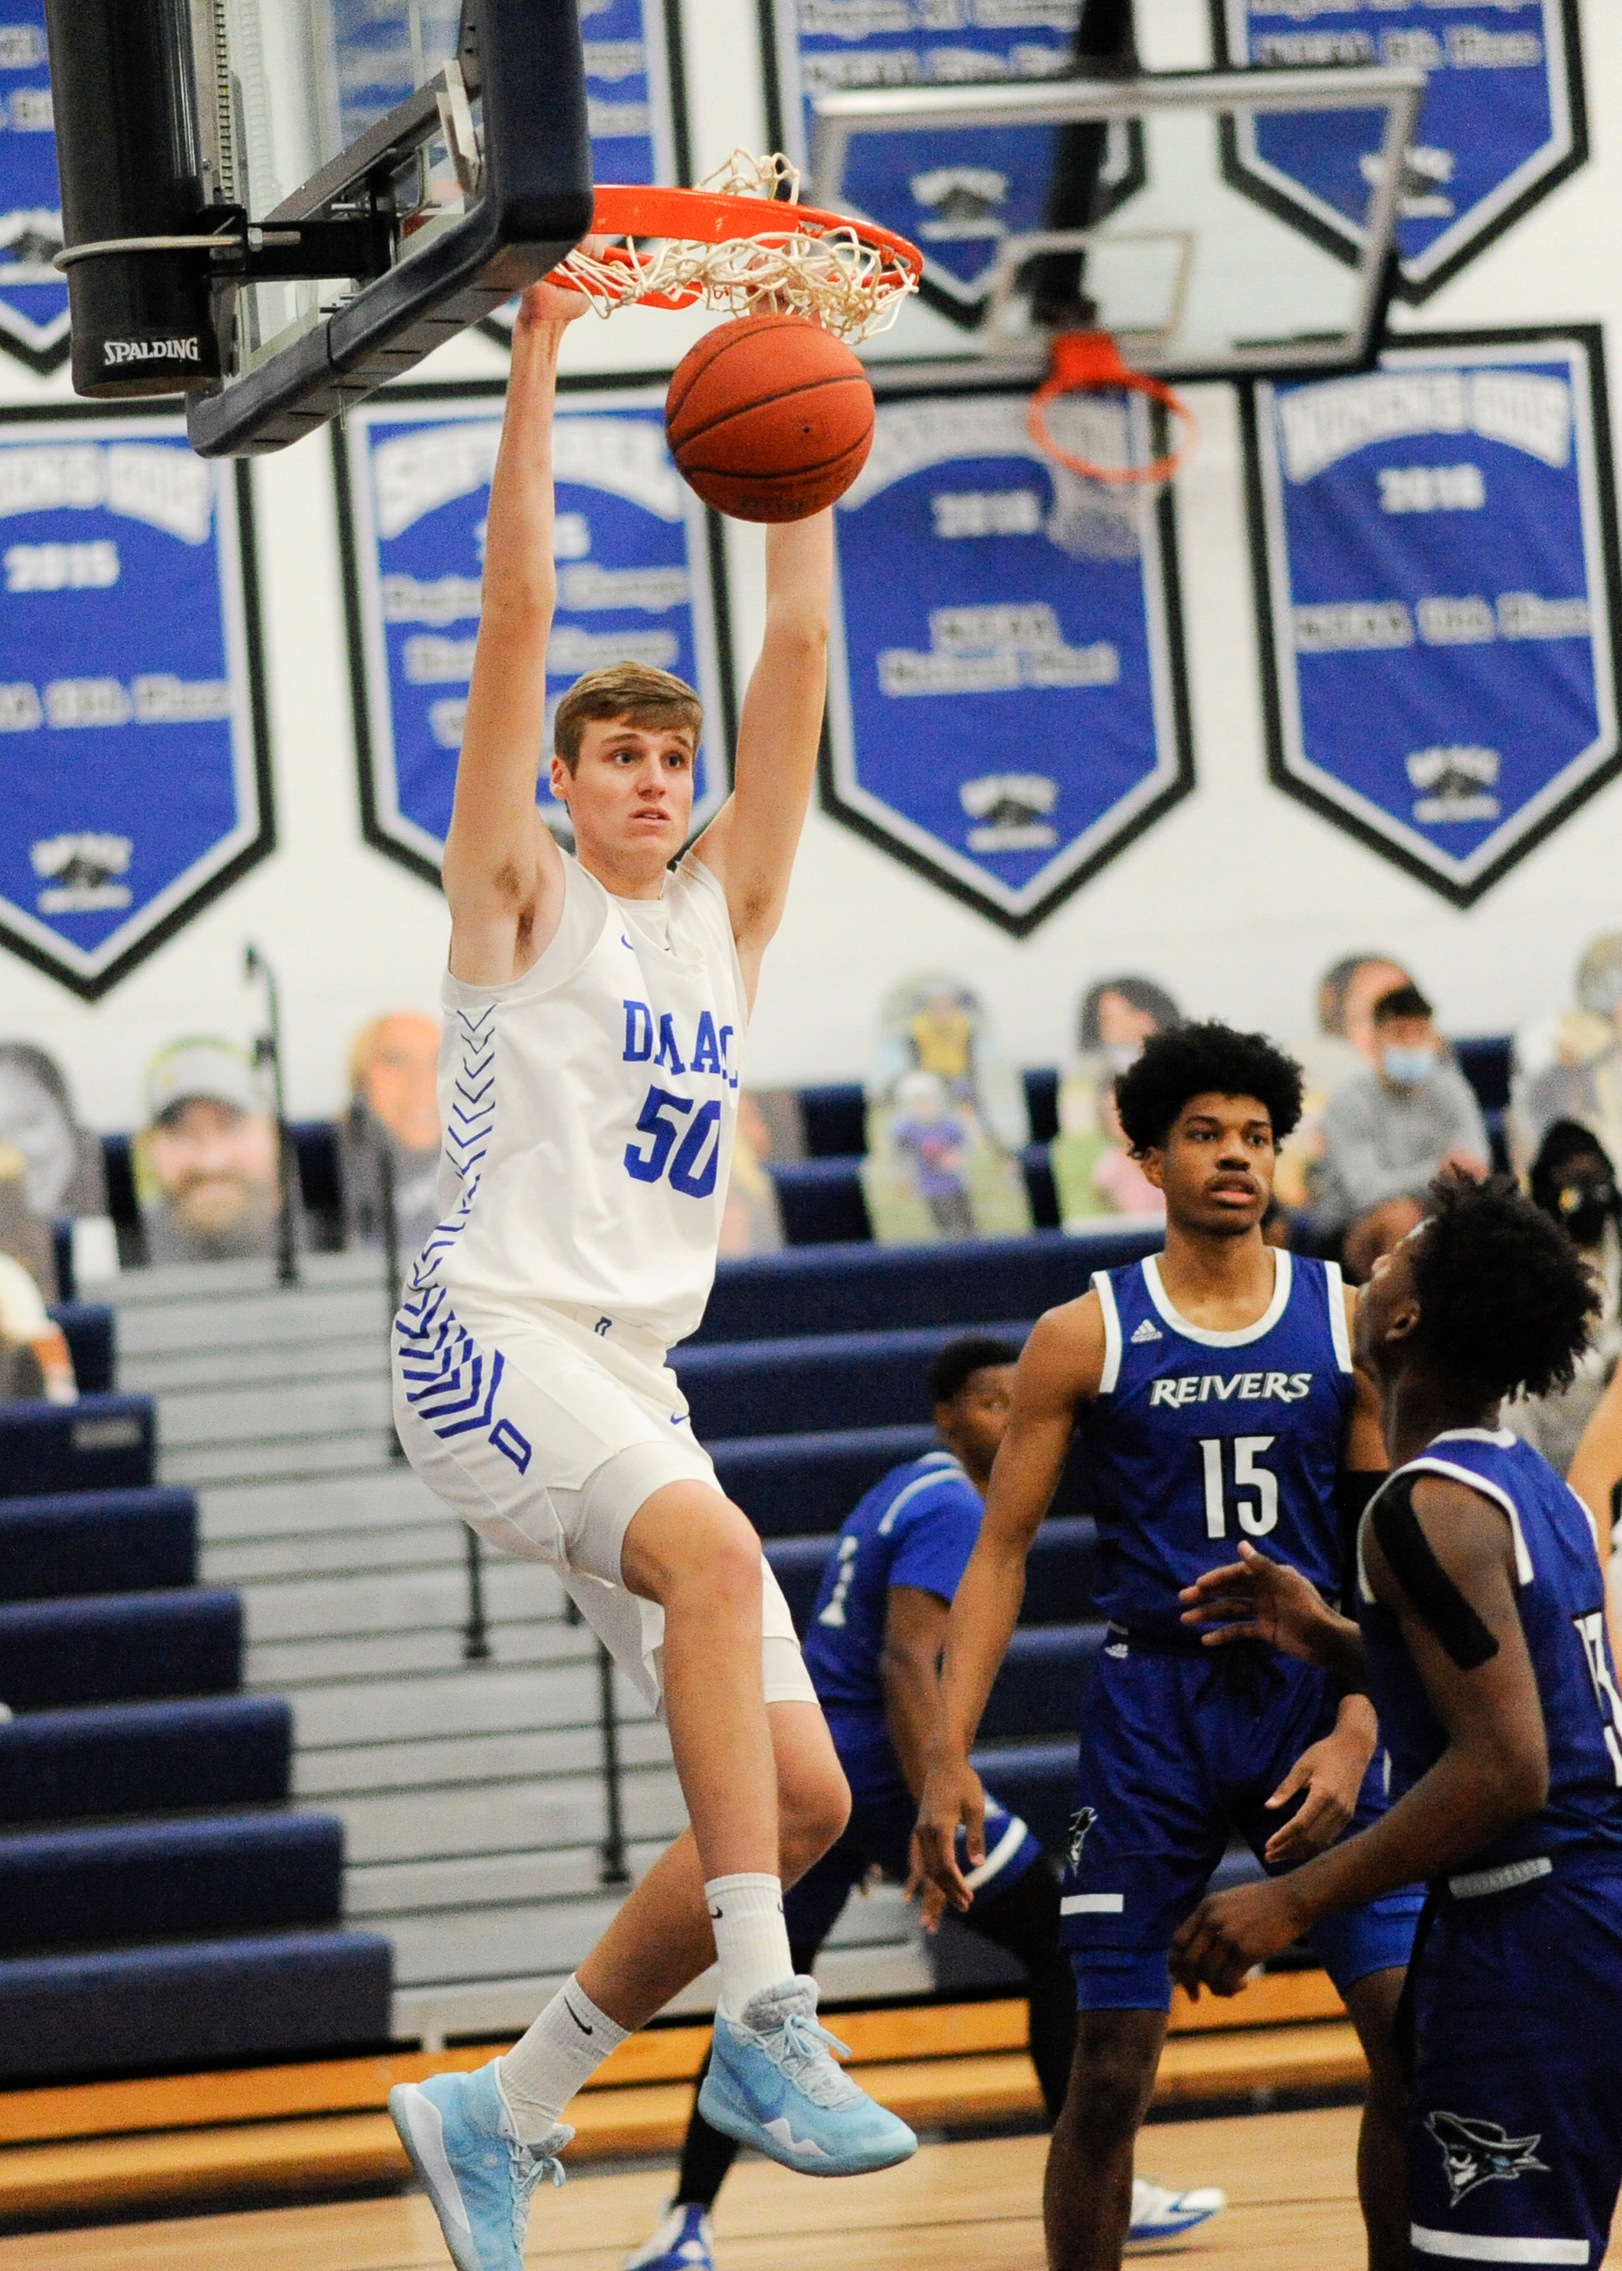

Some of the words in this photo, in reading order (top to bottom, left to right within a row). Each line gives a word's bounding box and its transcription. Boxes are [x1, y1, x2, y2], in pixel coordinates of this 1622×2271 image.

[103, 337, 200, 366] SPALDING
[623, 1084, 721, 1199] 50
[1150, 1372, 1313, 1408] REIVERS
[1199, 1436, 1279, 1539] 15
